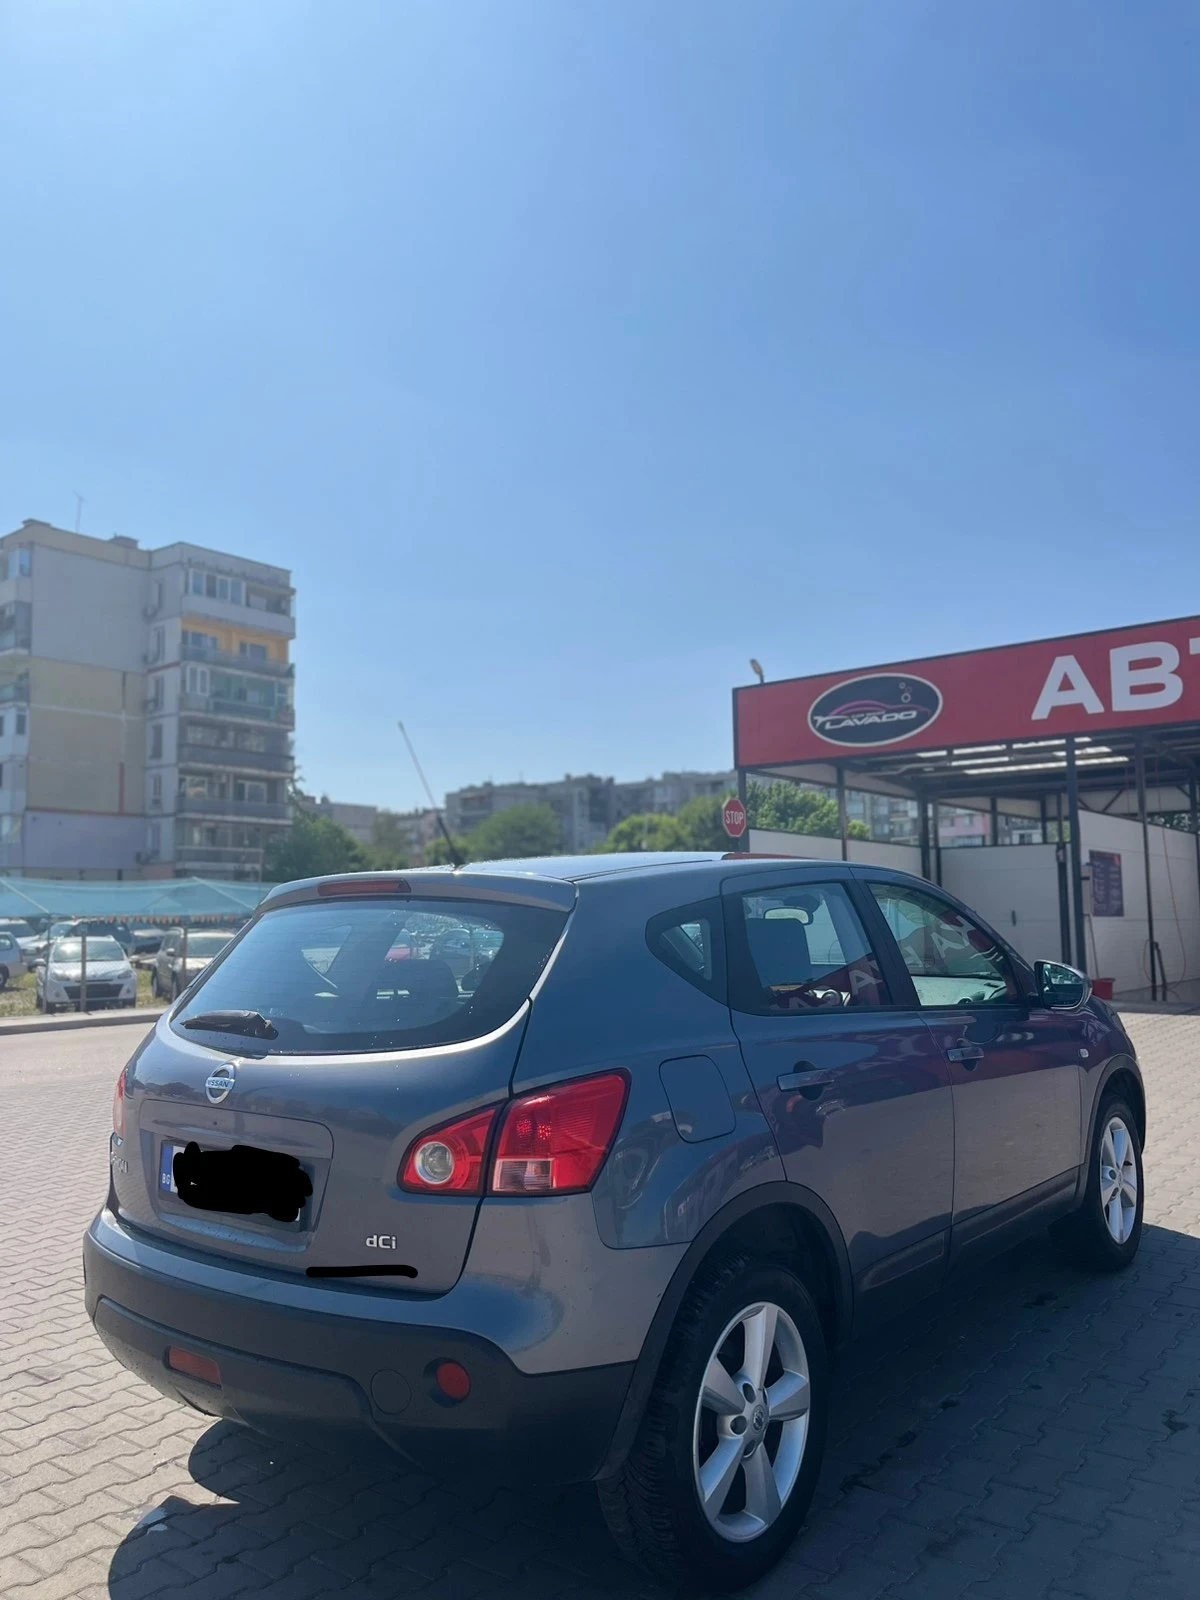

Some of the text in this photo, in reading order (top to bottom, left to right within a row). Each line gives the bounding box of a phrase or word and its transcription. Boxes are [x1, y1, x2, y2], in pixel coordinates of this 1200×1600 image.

[725, 810, 744, 825] STOP
[161, 1172, 171, 1185] BG
[365, 1234, 397, 1250] dCi
